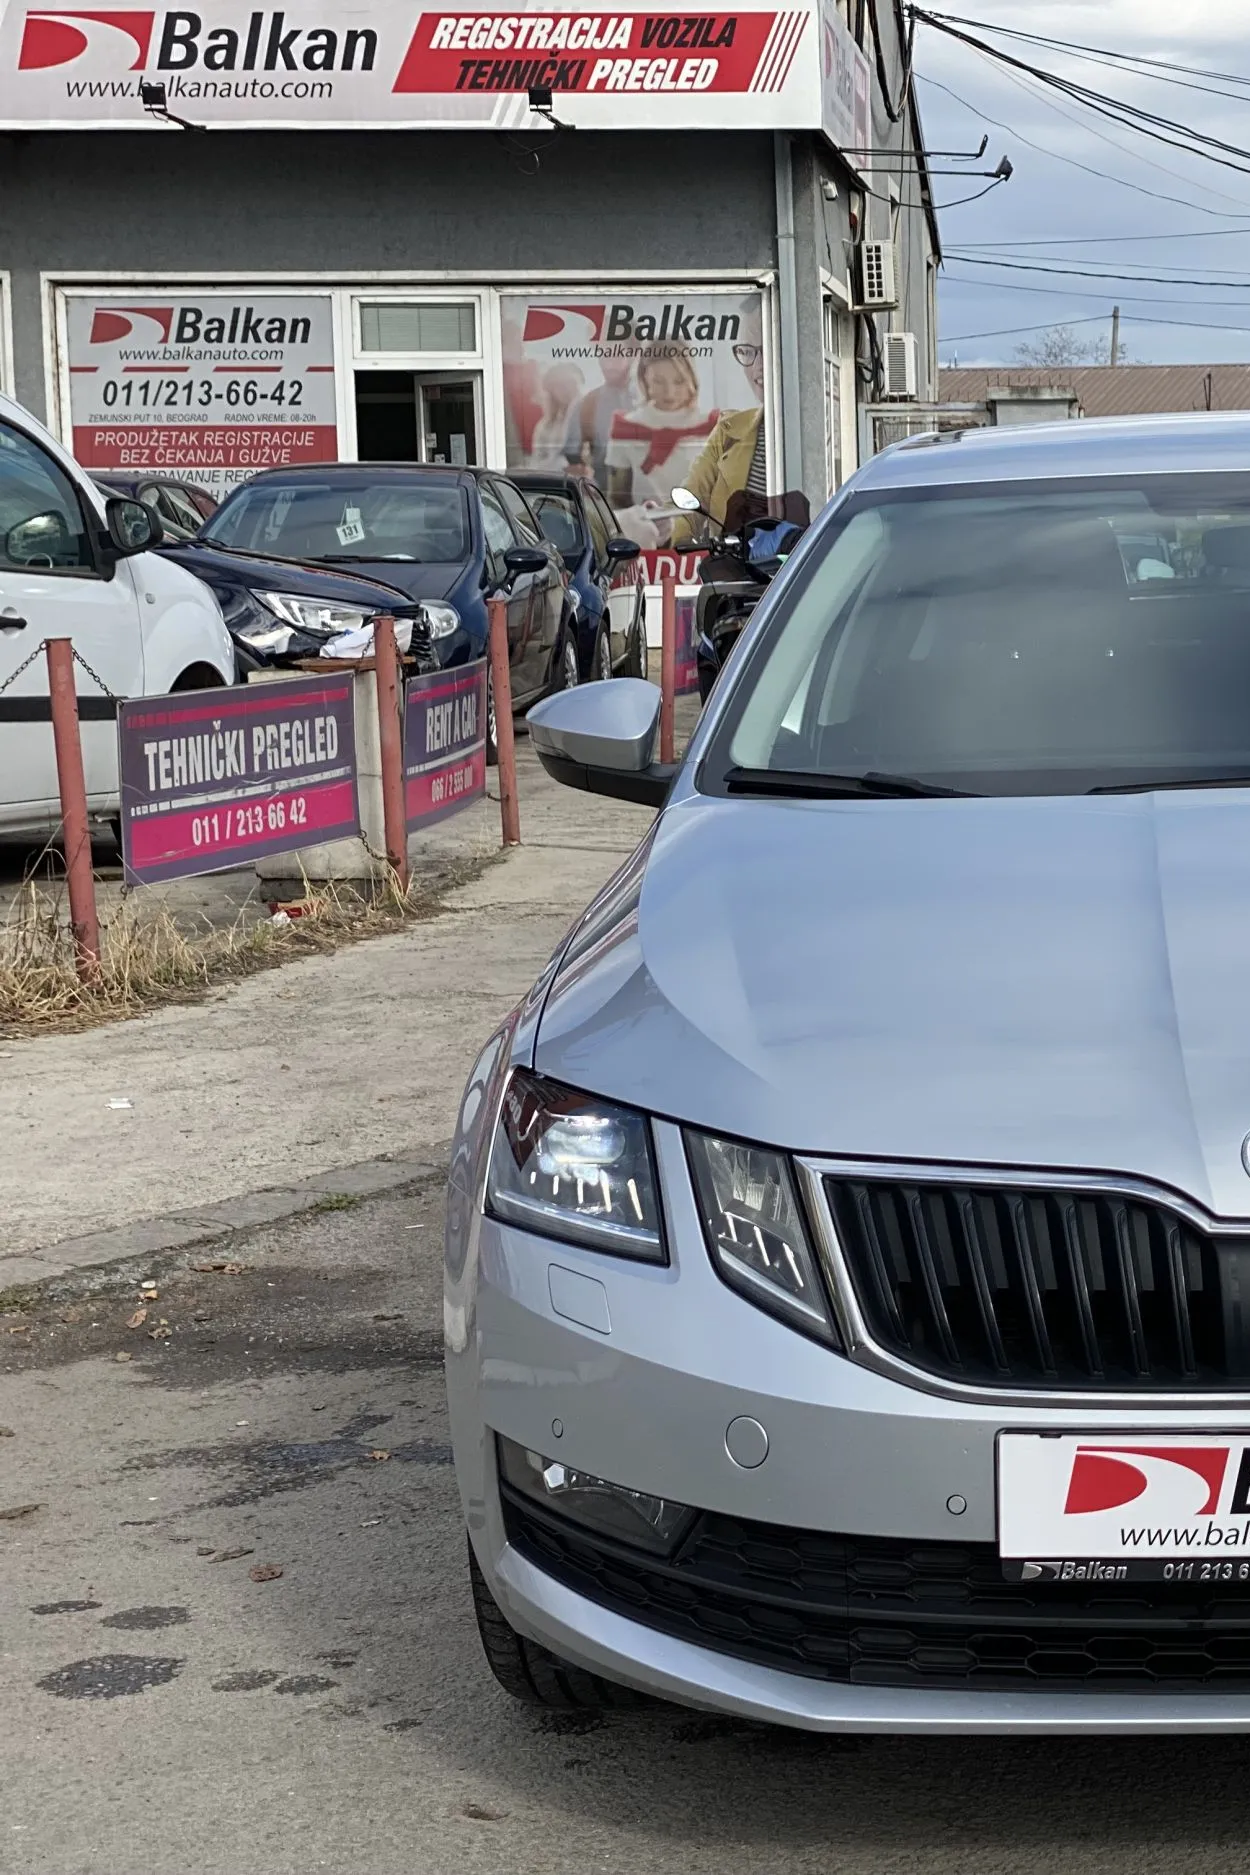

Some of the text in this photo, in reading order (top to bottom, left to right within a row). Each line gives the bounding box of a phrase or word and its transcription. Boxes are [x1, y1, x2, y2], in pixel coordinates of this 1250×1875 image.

[157, 11, 377, 71] Balkan
[429, 17, 738, 50] REGISTRACIJA VOZILA
[455, 51, 719, 91] TEHNIČKI PREGLED
[175, 307, 312, 344] Balkan
[606, 304, 740, 341] Balkan
[118, 346, 284, 361] www.balkanauto.com
[551, 344, 713, 359] www.balkanauto.com
[102, 379, 304, 407] 011/213-66-42
[88, 413, 132, 423] ZEMUNSKI
[133, 413, 151, 422] PUT
[166, 413, 209, 423] BEOGRAD
[224, 413, 255, 422] RADNO
[94, 428, 315, 446] PRODUŽETAK REGISTRACIJE
[120, 446, 291, 464] BEZ ČEKANJA I GUŽVE
[342, 524, 359, 538] 131
[426, 693, 477, 753] RENT A CAR
[144, 715, 339, 791] TEHNIČKI PREGLED
[192, 797, 307, 846] 011 / 213 66 42
[1061, 1561, 1128, 1580] Balkan
[1162, 1563, 1195, 1580] 011
[1200, 1563, 1233, 1580] 213
